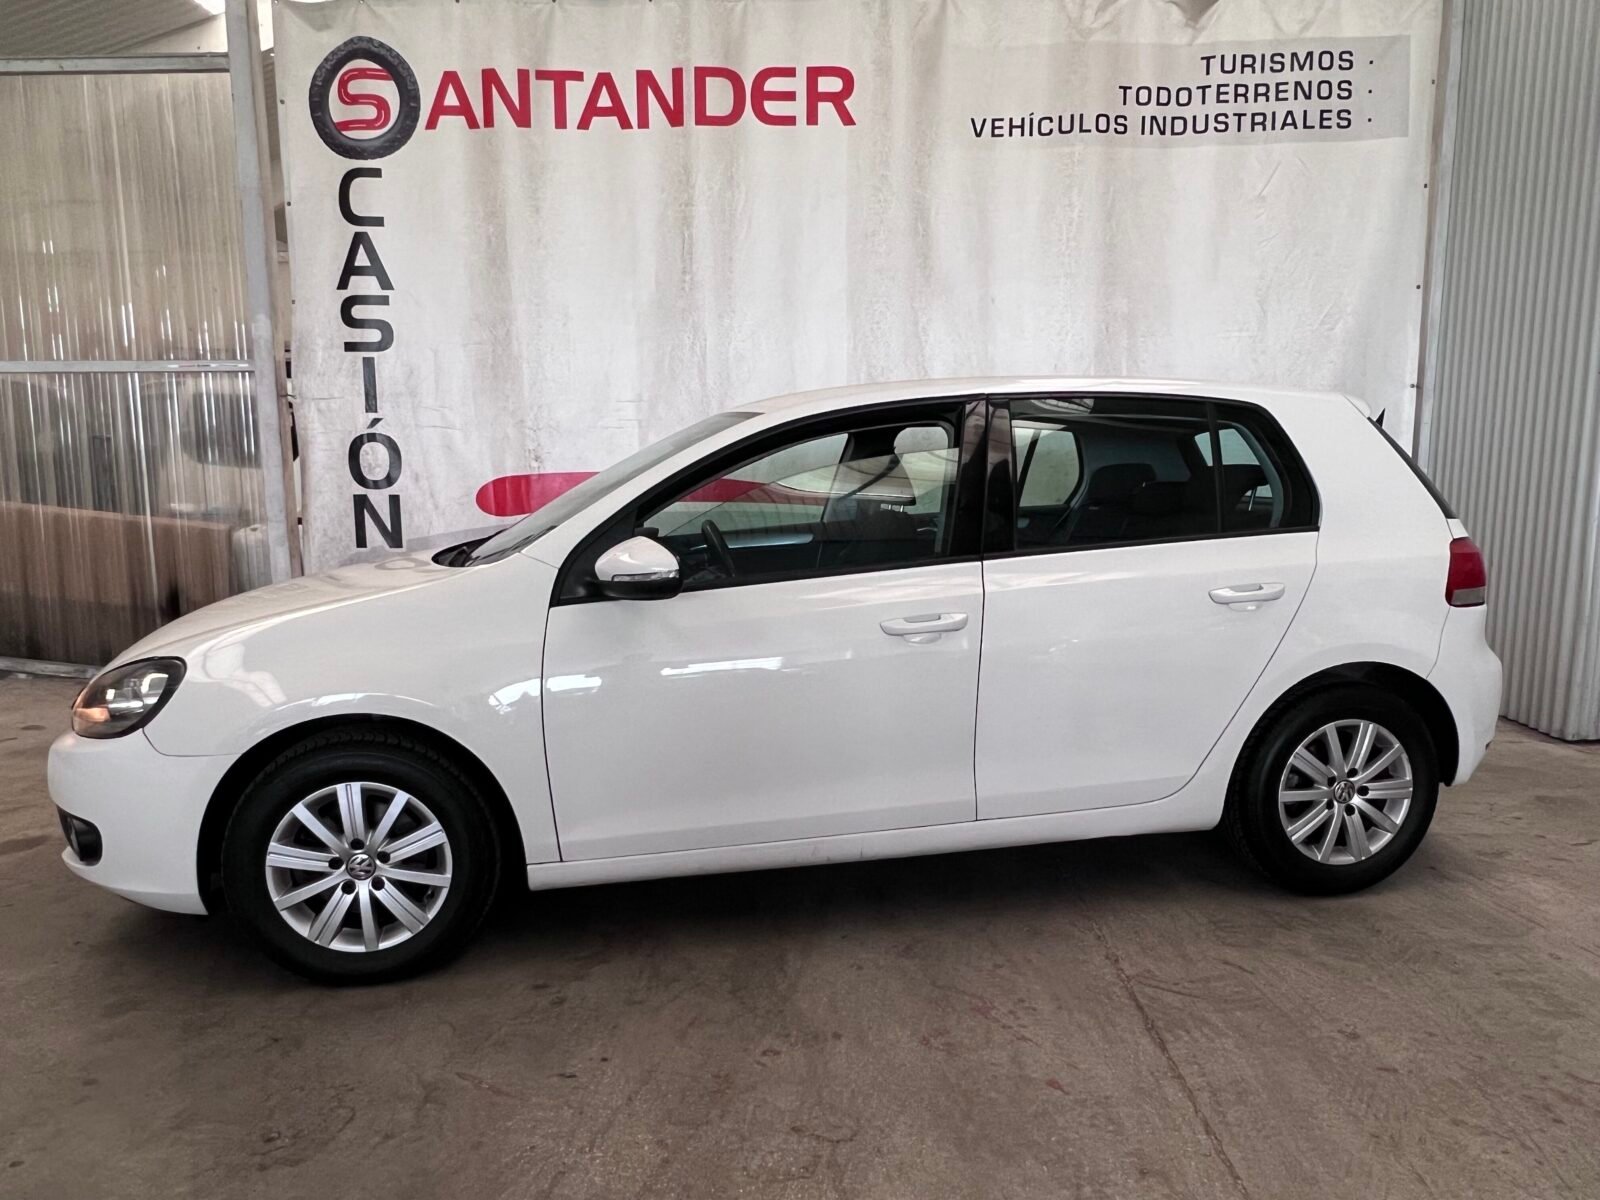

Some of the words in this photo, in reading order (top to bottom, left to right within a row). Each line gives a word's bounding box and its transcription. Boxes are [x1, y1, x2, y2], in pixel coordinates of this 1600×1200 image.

[1201, 50, 1355, 76] TURISMOS
[1118, 80, 1353, 106] TODOTERRENOS
[970, 112, 1129, 138] VEHÍCULOS
[1140, 109, 1353, 136] INDUSTRIALES
